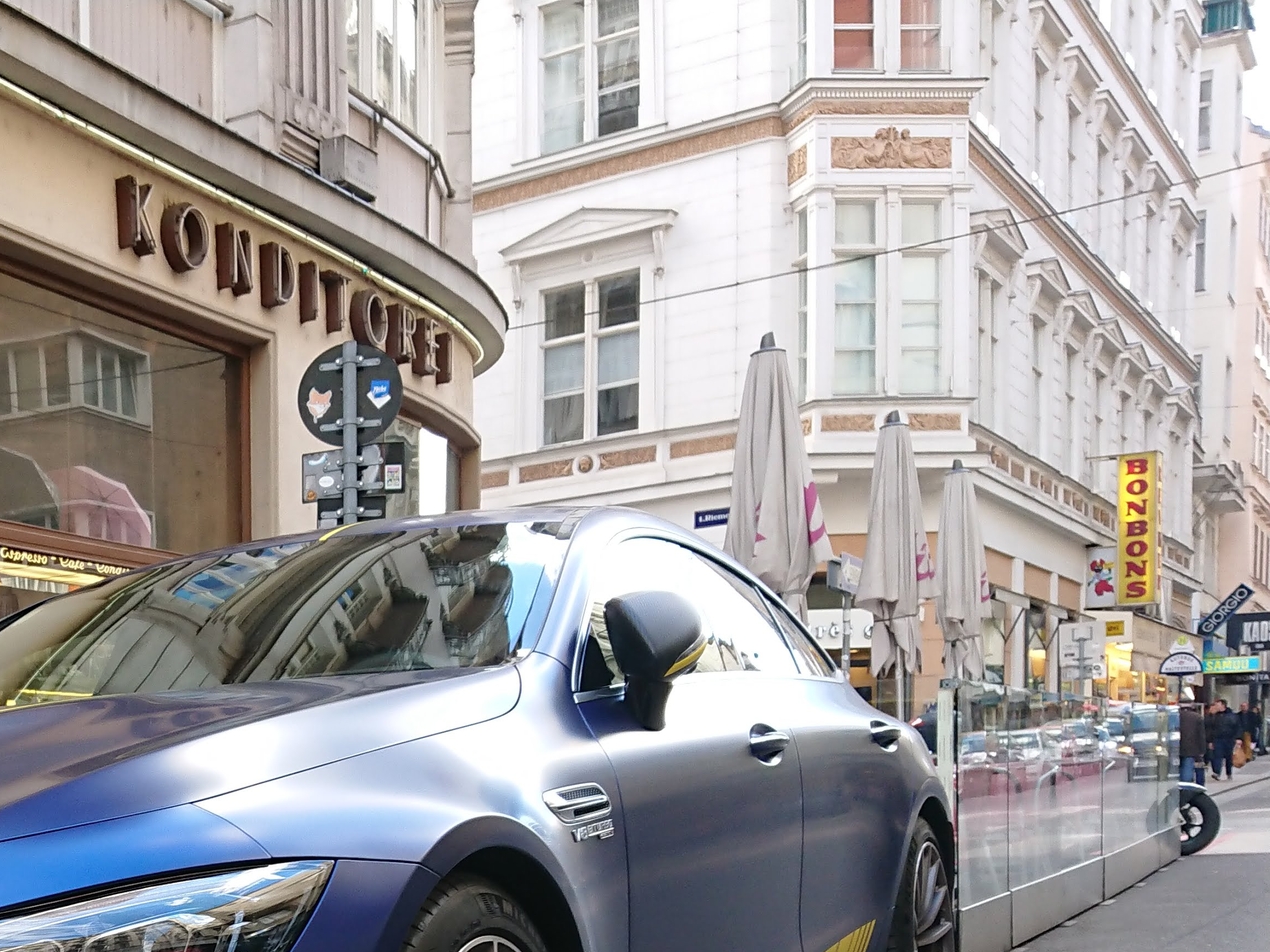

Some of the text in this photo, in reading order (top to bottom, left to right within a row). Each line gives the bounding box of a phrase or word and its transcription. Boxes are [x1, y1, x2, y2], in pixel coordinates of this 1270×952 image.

[115, 174, 453, 385] KONDITOREI
[1125, 458, 1149, 599] BONBONS
[0, 546, 48, 565] Espresso
[1201, 587, 1249, 634] GIORGIO
[1243, 620, 1270, 643] KAO
